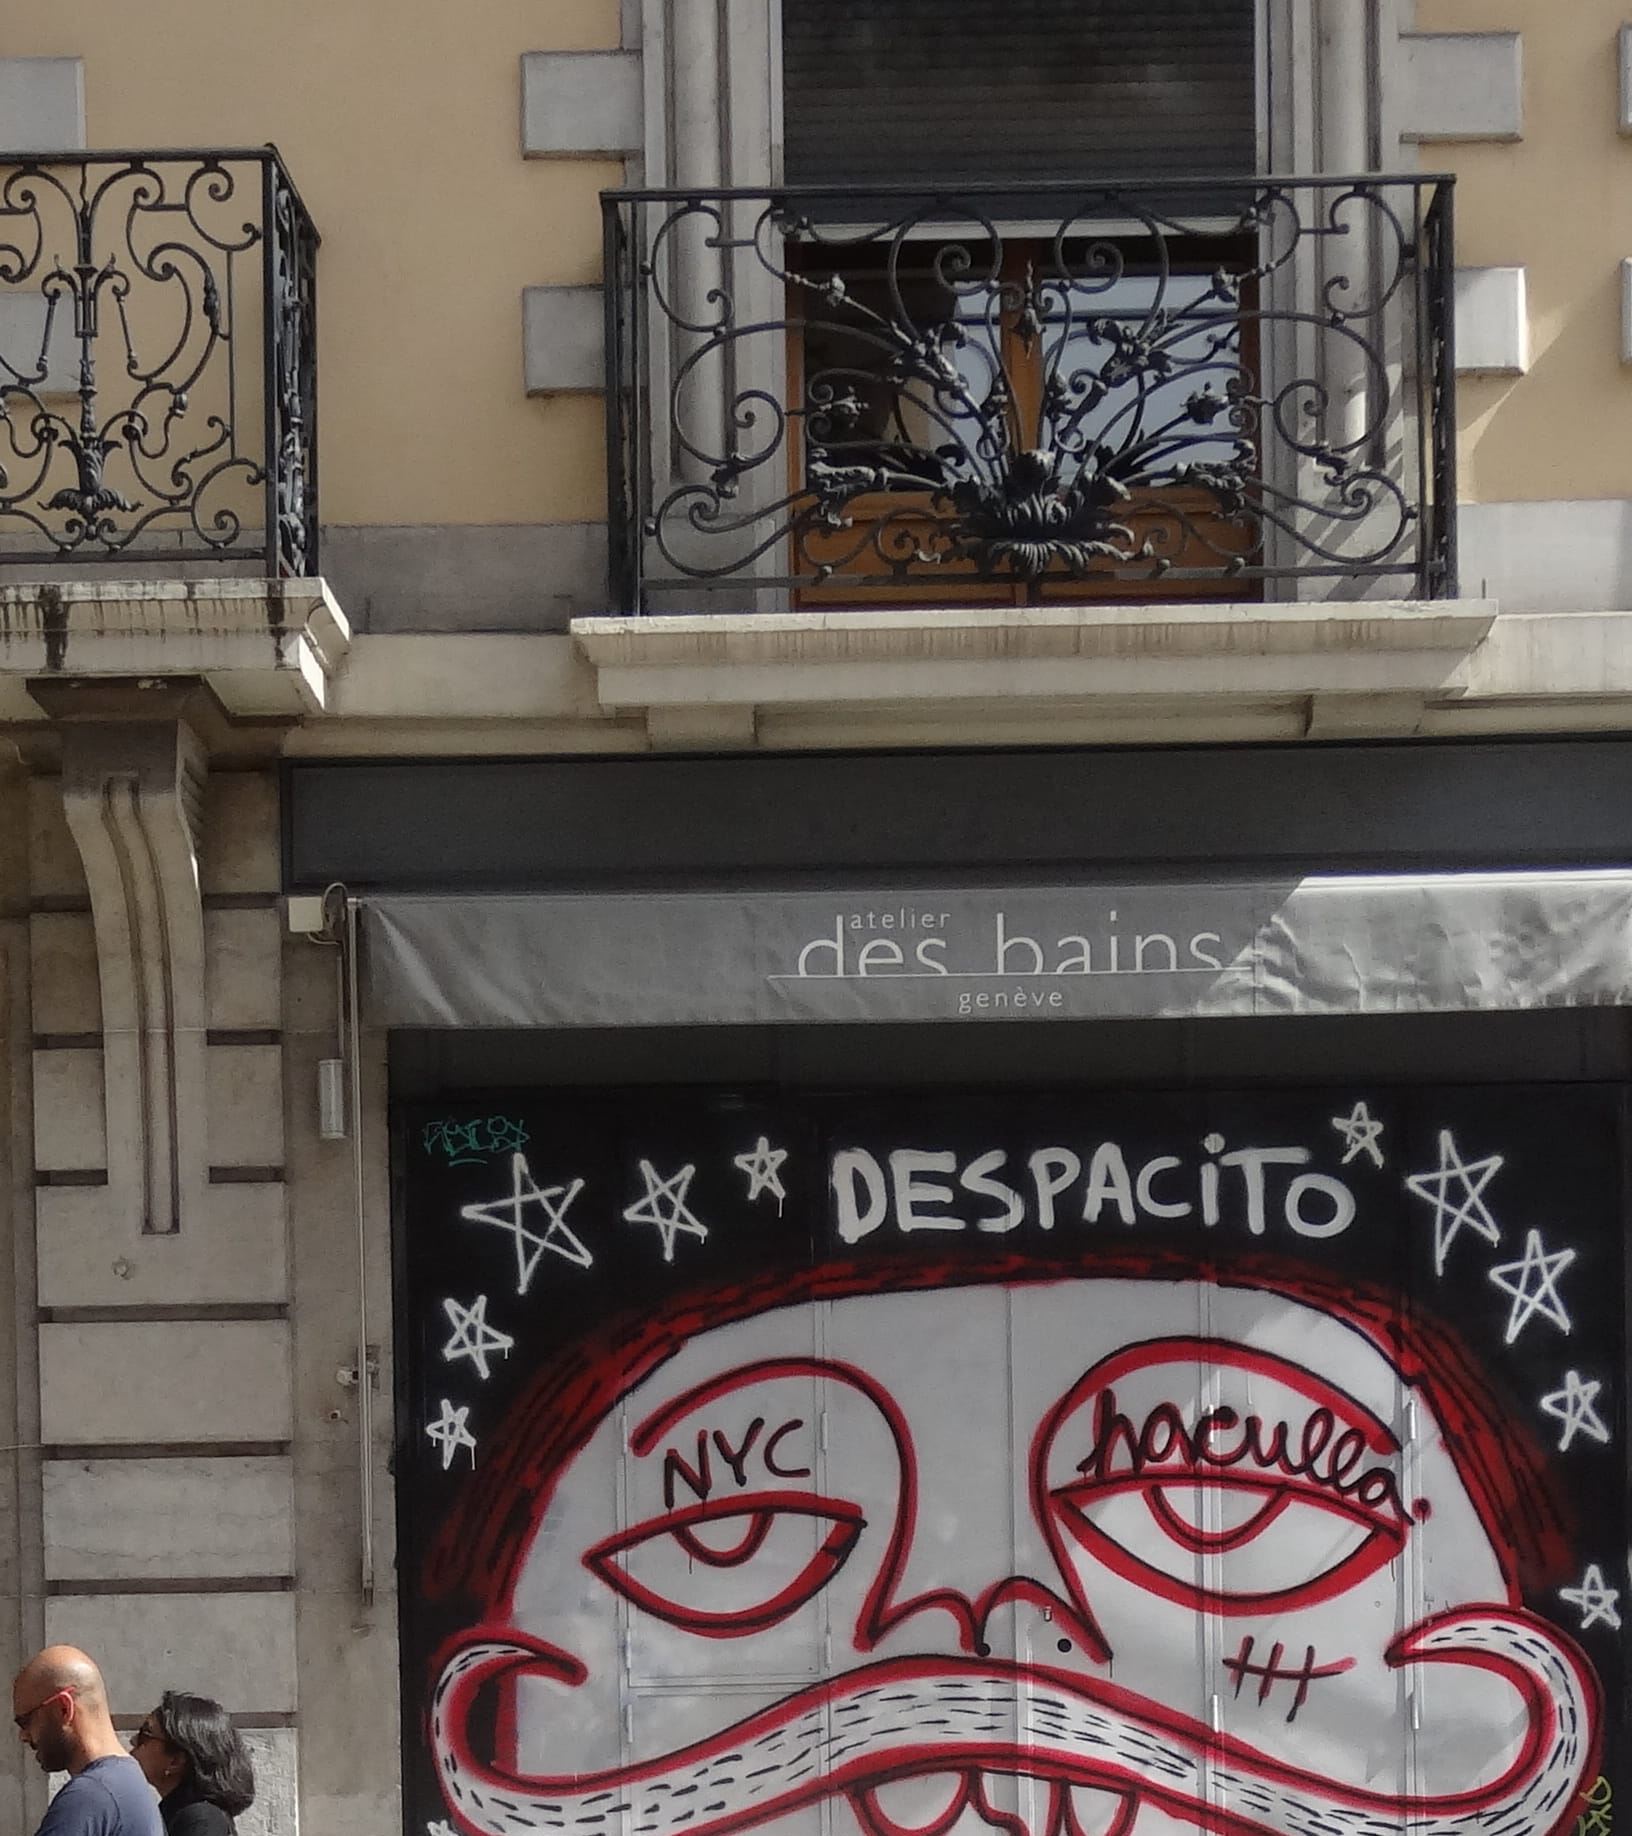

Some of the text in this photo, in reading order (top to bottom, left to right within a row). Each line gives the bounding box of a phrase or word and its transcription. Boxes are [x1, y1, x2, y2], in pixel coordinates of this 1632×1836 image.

[849, 907, 952, 930] atelier
[798, 910, 1224, 977] des bains
[958, 986, 1064, 1015] genève
[664, 1417, 812, 1512] NYC
